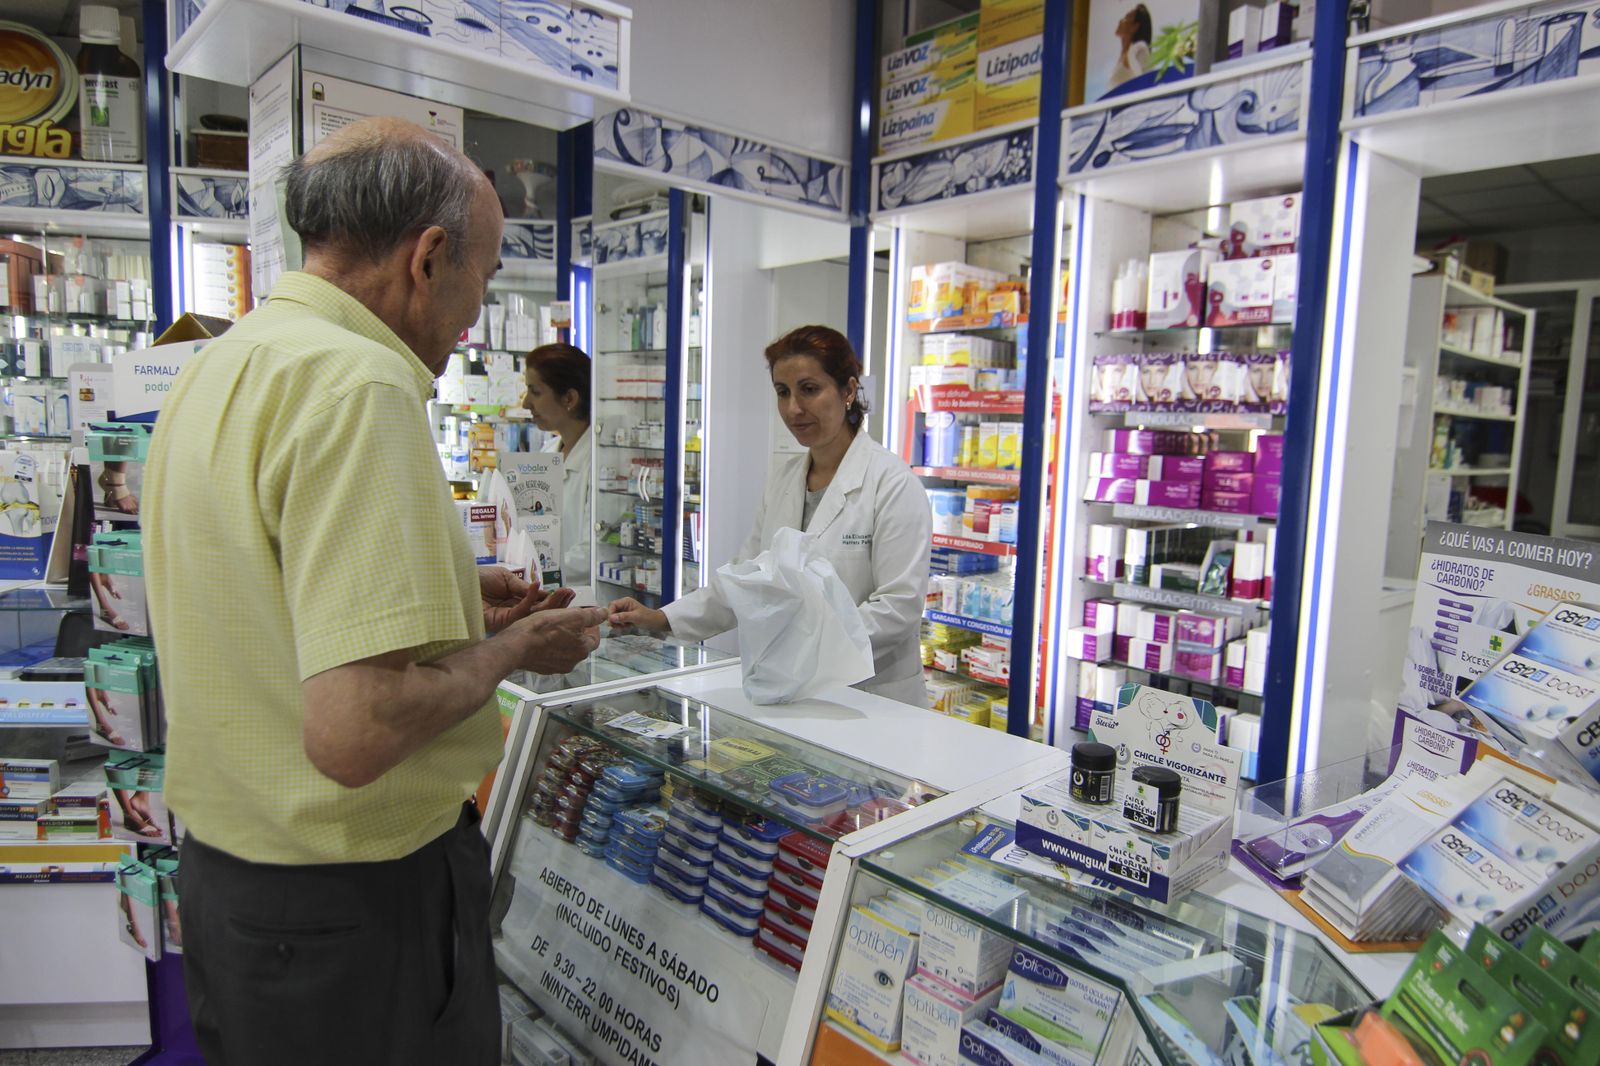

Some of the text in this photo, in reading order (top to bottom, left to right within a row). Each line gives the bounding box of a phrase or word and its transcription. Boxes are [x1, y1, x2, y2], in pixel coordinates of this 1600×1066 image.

[986, 44, 1042, 78] Lizipad
[144, 382, 172, 393] podo
[1439, 530, 1593, 571] ¿QUÉ VAS A COMER HOY?
[1431, 558, 1496, 582] ¿HIDRATOS DE
[1437, 571, 1486, 592] CARBONO?
[1554, 609, 1591, 628] CB12
[1502, 660, 1538, 679] CB12
[1414, 726, 1447, 746] ¿HIDRATOS
[1417, 735, 1450, 754] CARBONO?
[1134, 750, 1164, 765] CHICLE
[1166, 759, 1227, 785] VIGORIZANTE
[1495, 788, 1529, 811] CB12
[1441, 833, 1473, 858] CB12
[539, 867, 720, 1004] ABIERTO DE LUNES A SÁBADO
[927, 909, 977, 943] optiben
[1500, 906, 1543, 943] CB12
[555, 902, 681, 1010] (INCLUIDO FESTIVOS)
[849, 925, 905, 965] optiben
[1014, 951, 1065, 986] Opticalm
[530, 935, 550, 957] DE
[553, 951, 576, 980] 9.30
[614, 1003, 663, 1054] HORAS
[907, 994, 959, 1031] optiben
